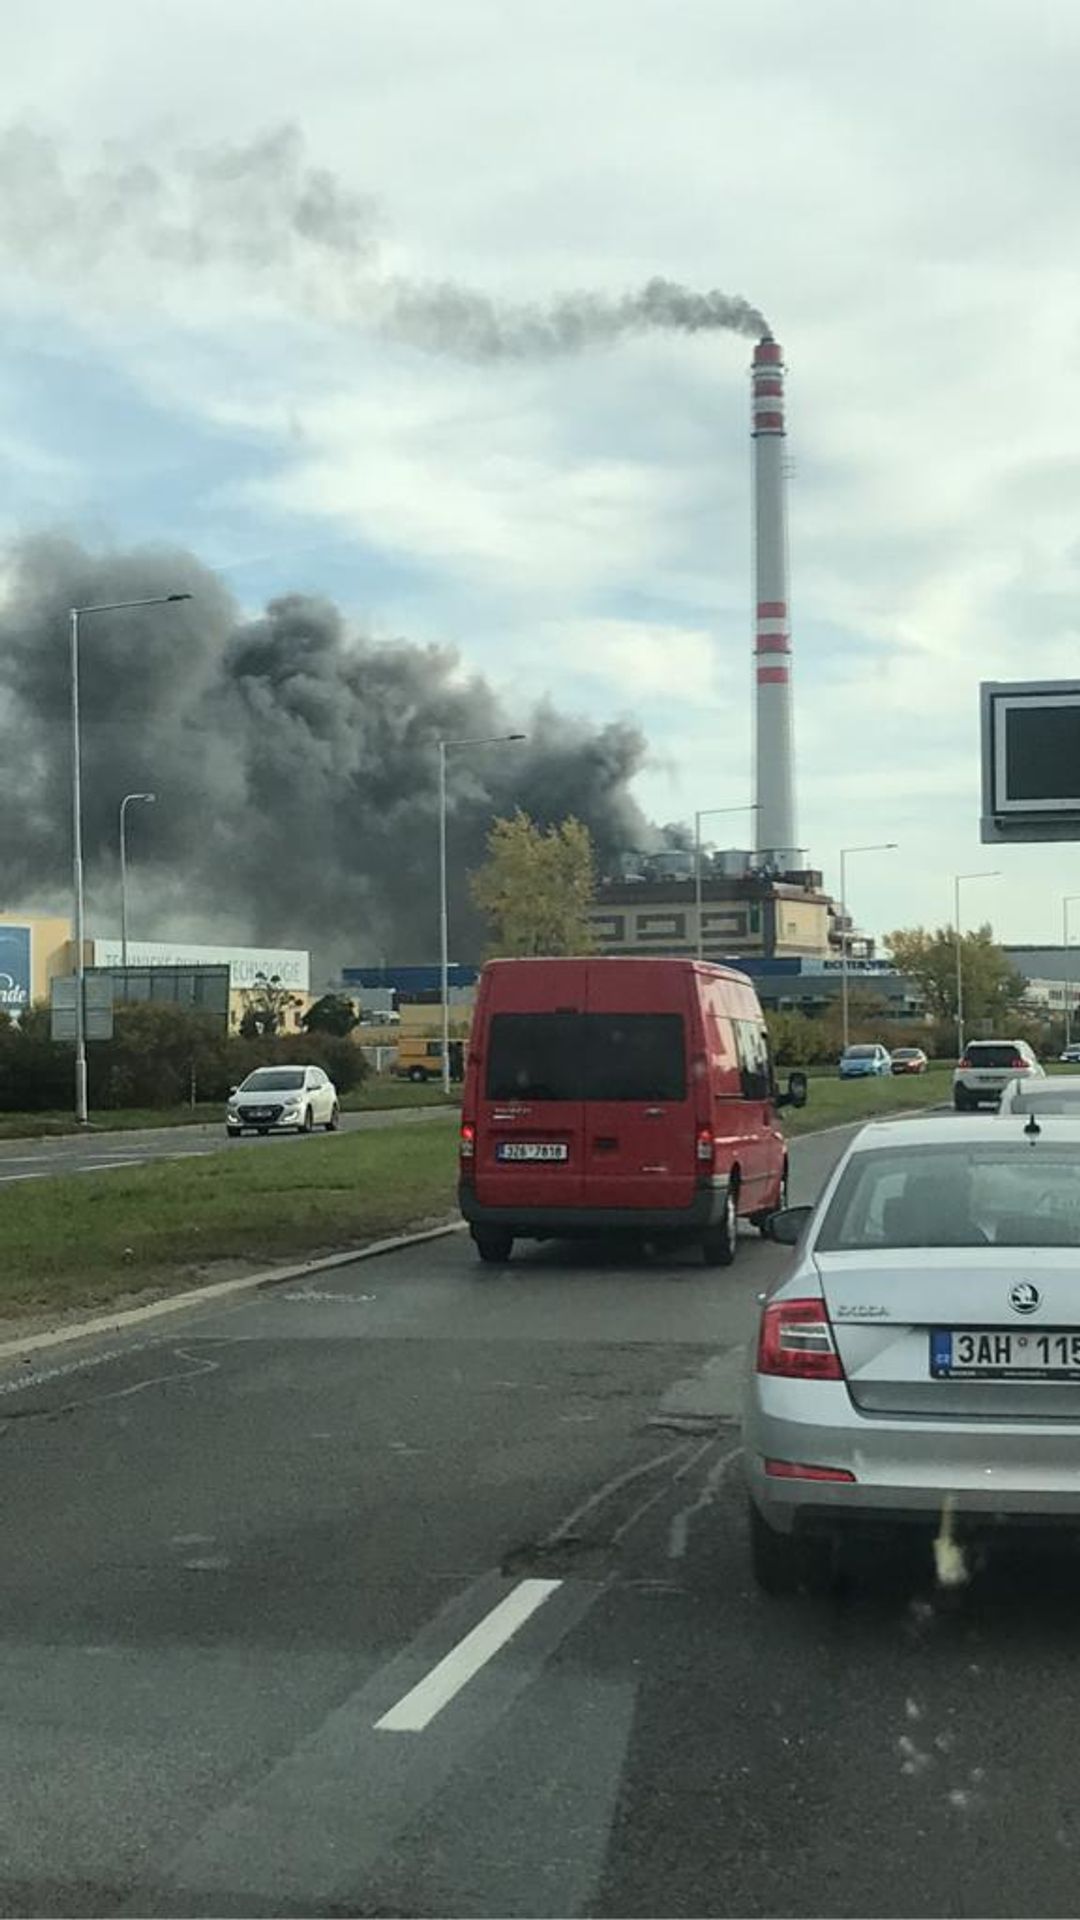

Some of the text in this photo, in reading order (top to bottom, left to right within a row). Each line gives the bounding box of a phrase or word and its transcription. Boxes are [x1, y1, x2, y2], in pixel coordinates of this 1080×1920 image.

[228, 959, 300, 983] ECHNOLOGIE
[958, 1335, 1080, 1365] 3AH 115
